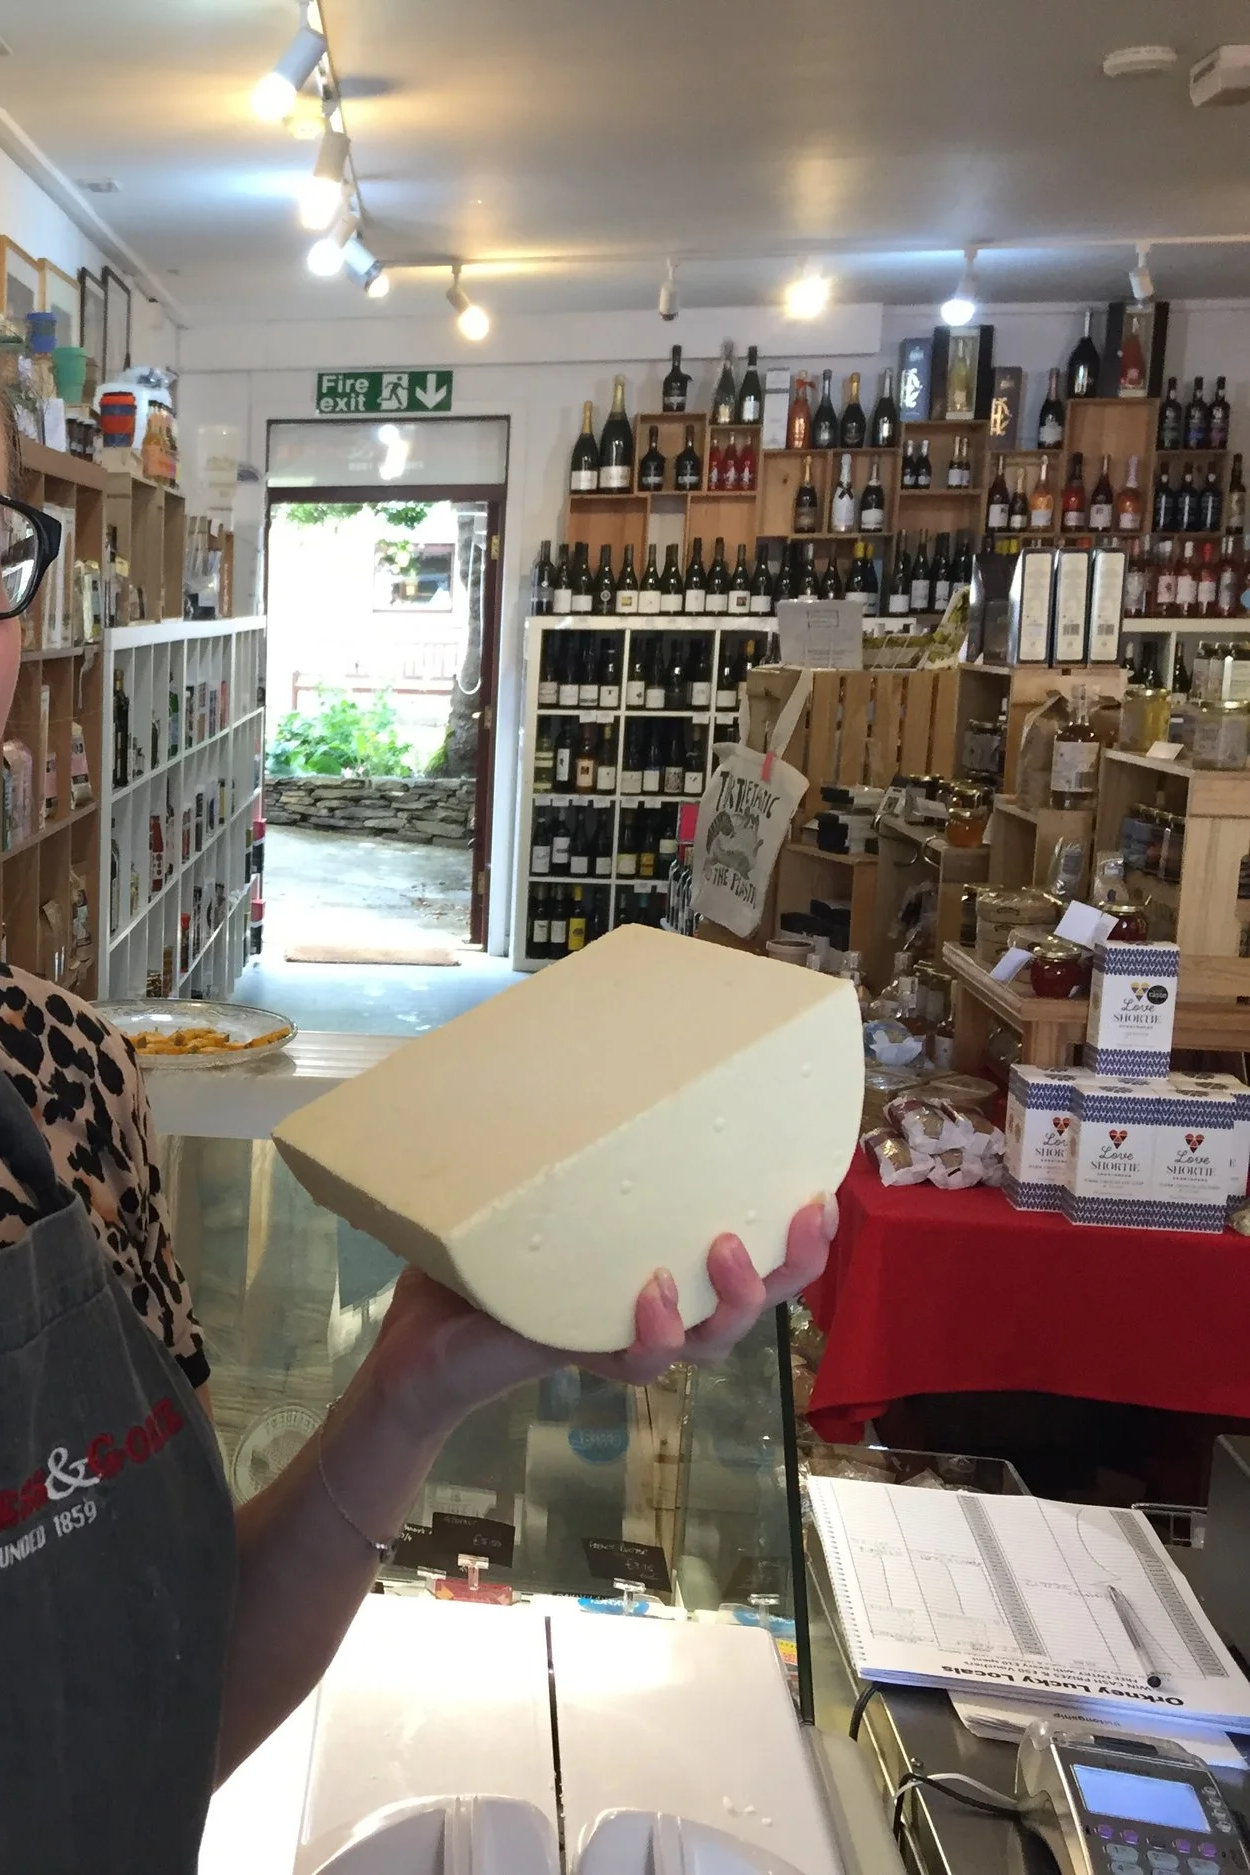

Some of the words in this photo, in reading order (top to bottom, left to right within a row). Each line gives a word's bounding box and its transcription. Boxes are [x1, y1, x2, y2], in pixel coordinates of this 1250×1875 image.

[321, 375, 369, 393] Fire
[318, 394, 366, 412] exit
[731, 873, 756, 909] PLASTI
[1121, 998, 1155, 1012] Love
[1035, 1148, 1065, 1158] SHOR
[1099, 1145, 1134, 1161] Love
[1174, 1150, 1211, 1165] Love
[1091, 1161, 1141, 1173] SHORTIE
[45, 1445, 100, 1500] &
[52, 1498, 98, 1540] 1859
[941, 1664, 1015, 1683] Locals
[1022, 1674, 1091, 1693] Lucky
[1097, 1686, 1185, 1707] Orkney
